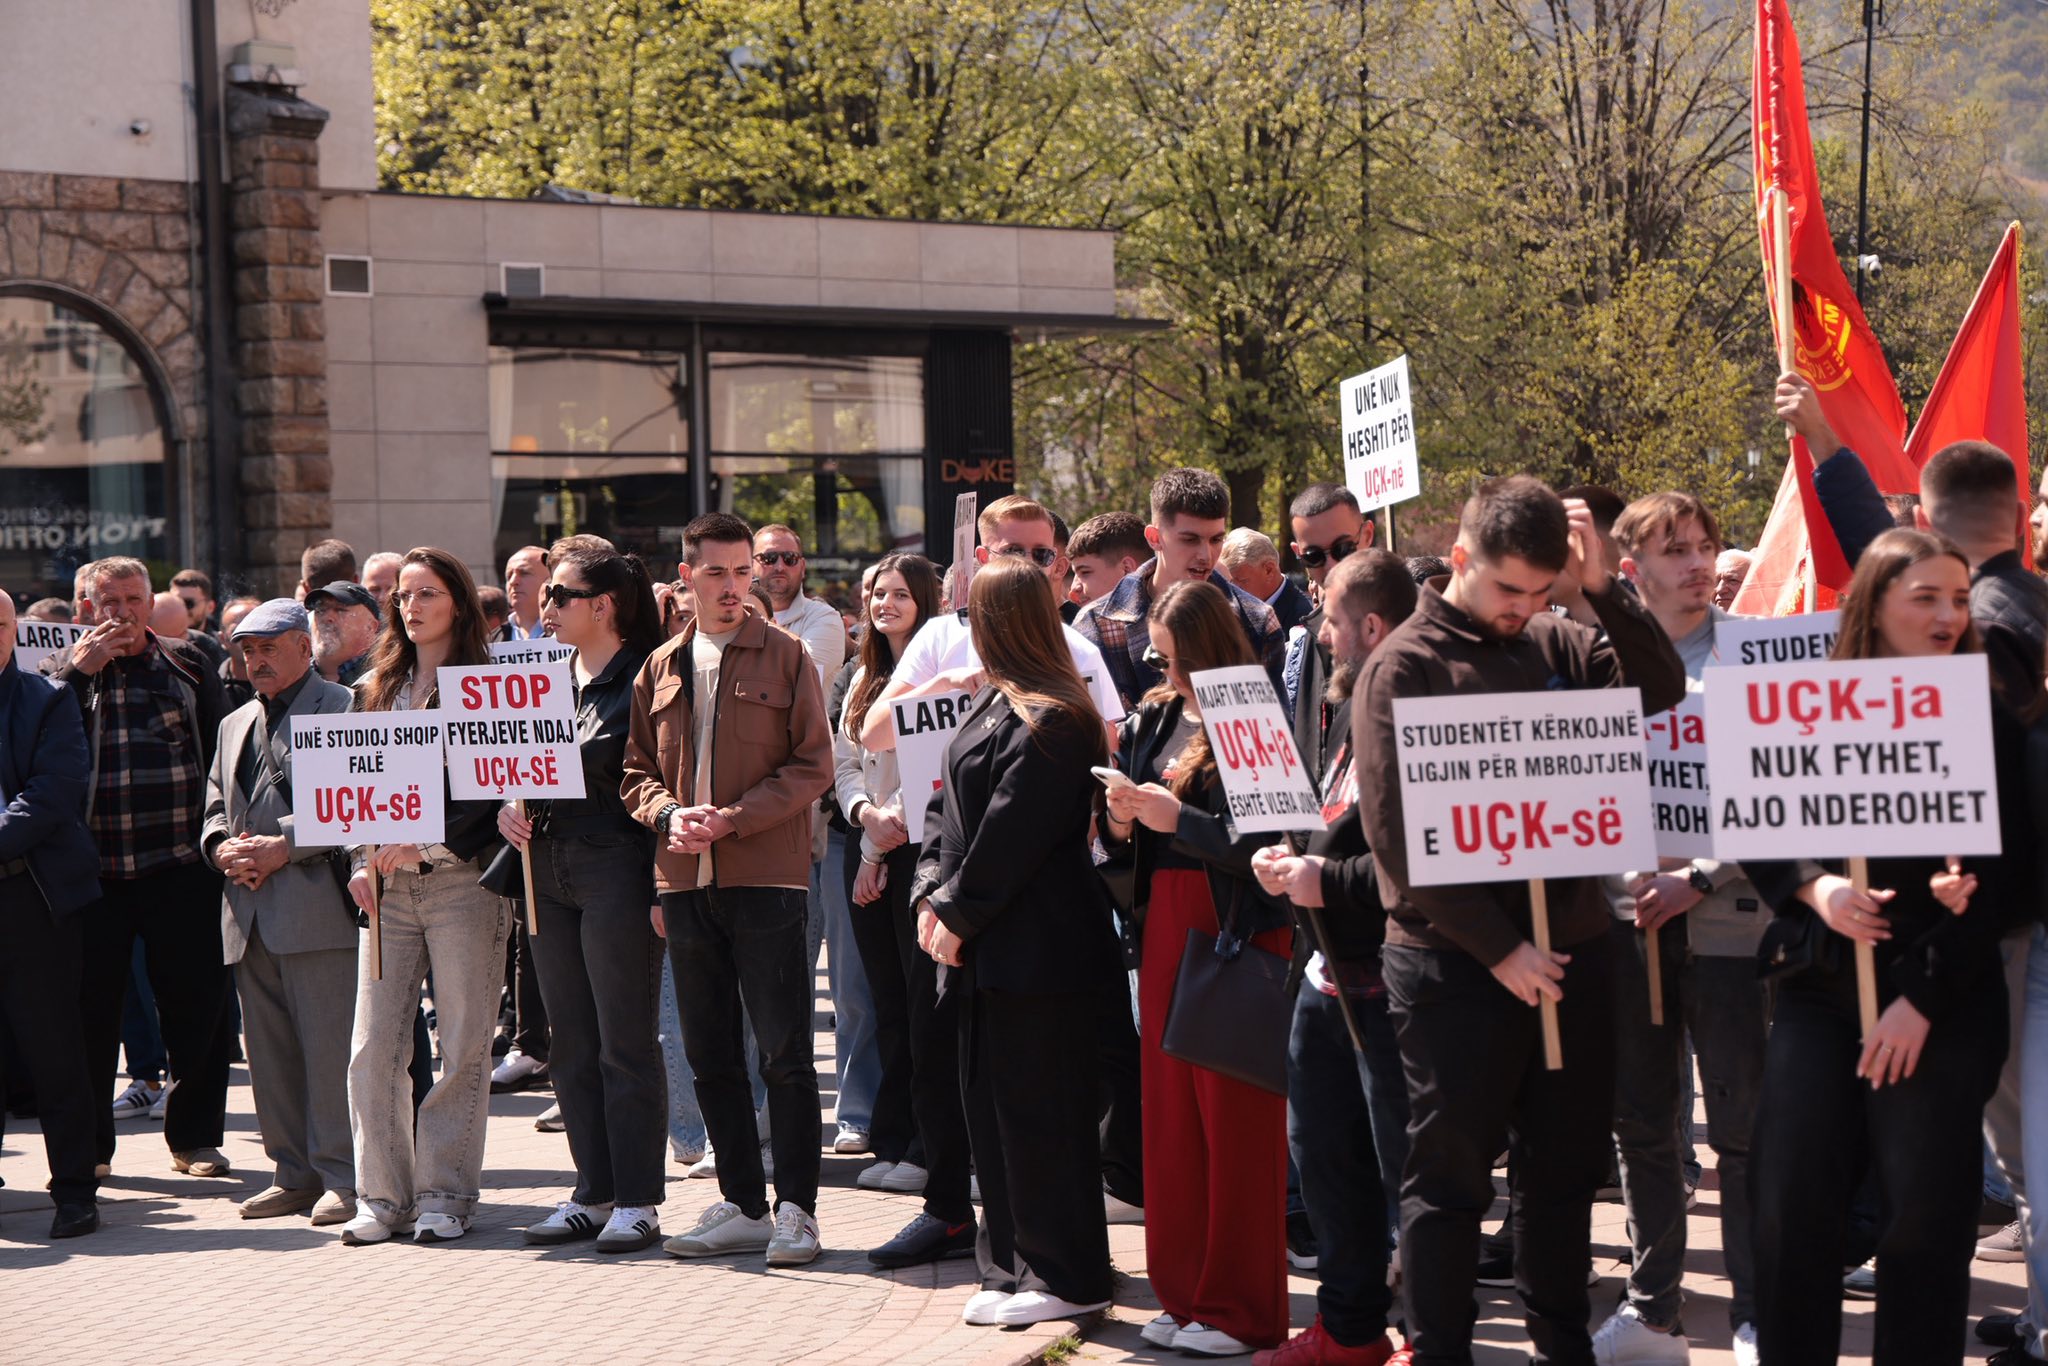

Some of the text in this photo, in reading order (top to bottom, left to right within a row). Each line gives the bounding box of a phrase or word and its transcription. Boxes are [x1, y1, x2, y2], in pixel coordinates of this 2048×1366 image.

[1355, 372, 1401, 415] UNË NUK
[1348, 408, 1411, 460] HESHTI PËR
[1364, 460, 1404, 503] UÇK-në
[16, 625, 65, 649] LARG
[1741, 632, 1838, 665] STUDEN
[461, 674, 551, 710] STOP
[1196, 683, 1230, 709] MJAFT
[1231, 682, 1249, 706] ME
[1746, 676, 1943, 735] UÇK-ja
[294, 726, 439, 749] UNË STUDIOJ SHQIP
[447, 719, 575, 746] FYERJEVE NDAJ
[1402, 710, 1639, 748] STUDENTËT KËRKOJNË
[349, 751, 384, 773] FALË
[1214, 718, 1297, 782] UÇK-ja
[1407, 752, 1643, 783] LIGJIN PËR MBROJTJEN
[1751, 741, 1950, 780] NUK FYHET,
[474, 749, 559, 794] UÇK-SË
[1649, 760, 1710, 796] YHET,
[315, 784, 422, 833] UÇK-së
[1228, 787, 1266, 818] ËSHTË
[1265, 791, 1299, 817] VLERA
[1722, 790, 1987, 829] AJO NDEROHET
[1424, 797, 1623, 866] E UÇK-së
